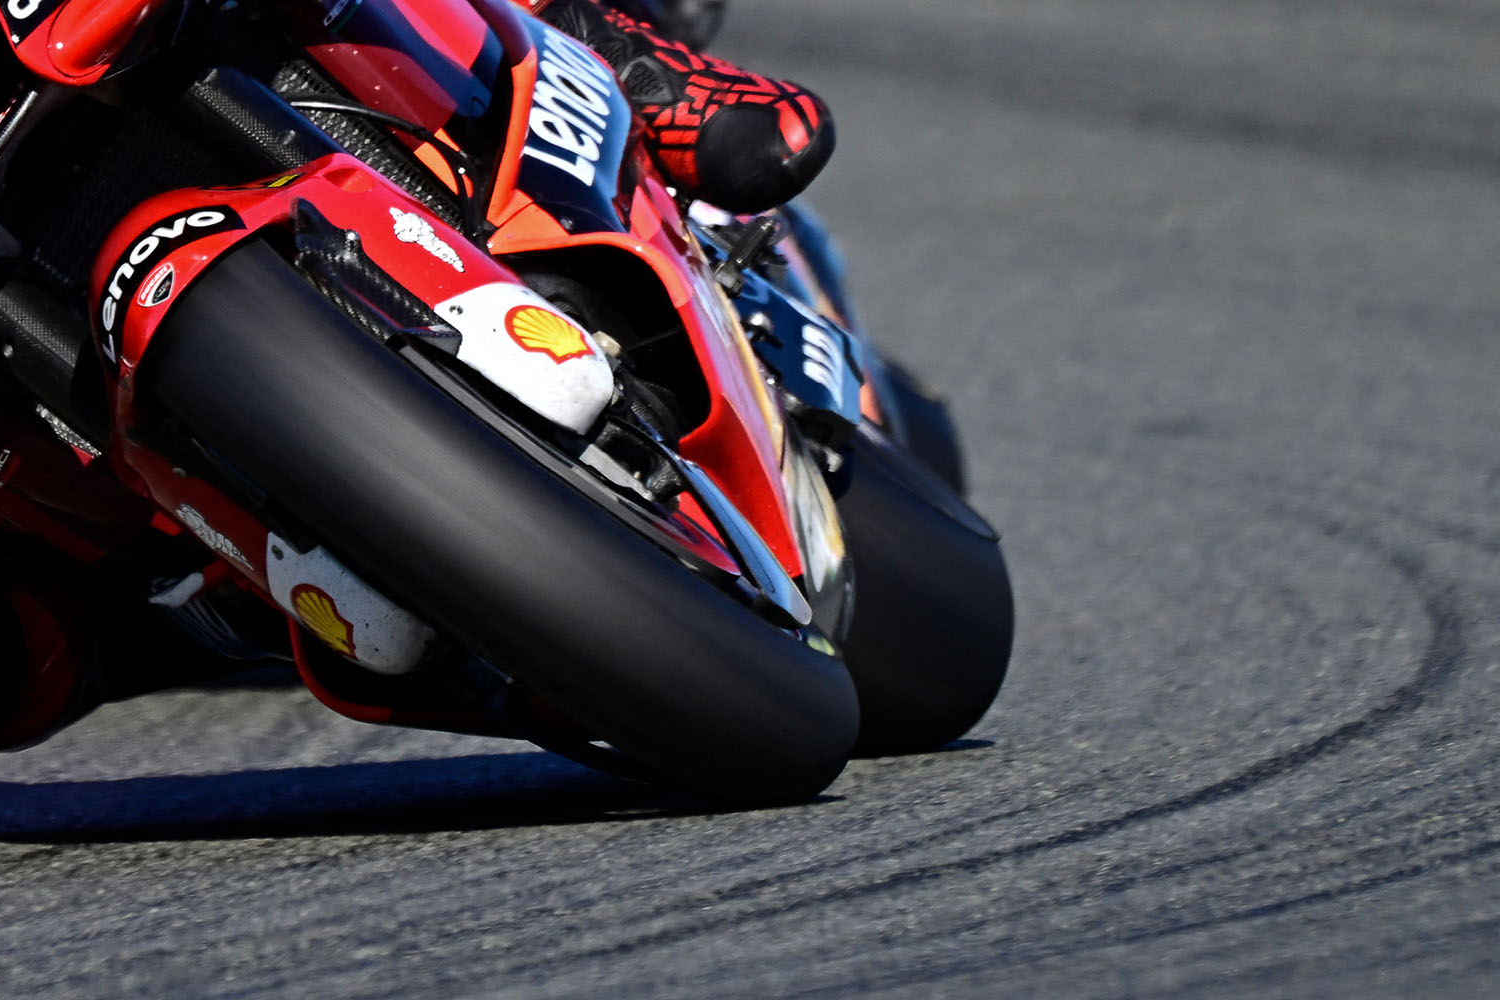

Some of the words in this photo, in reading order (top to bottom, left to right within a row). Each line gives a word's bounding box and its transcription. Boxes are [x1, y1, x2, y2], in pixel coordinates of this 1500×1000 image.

[521, 29, 611, 187] Lenovo
[101, 211, 226, 365] Lenovo
[141, 265, 168, 301] DUCATI
